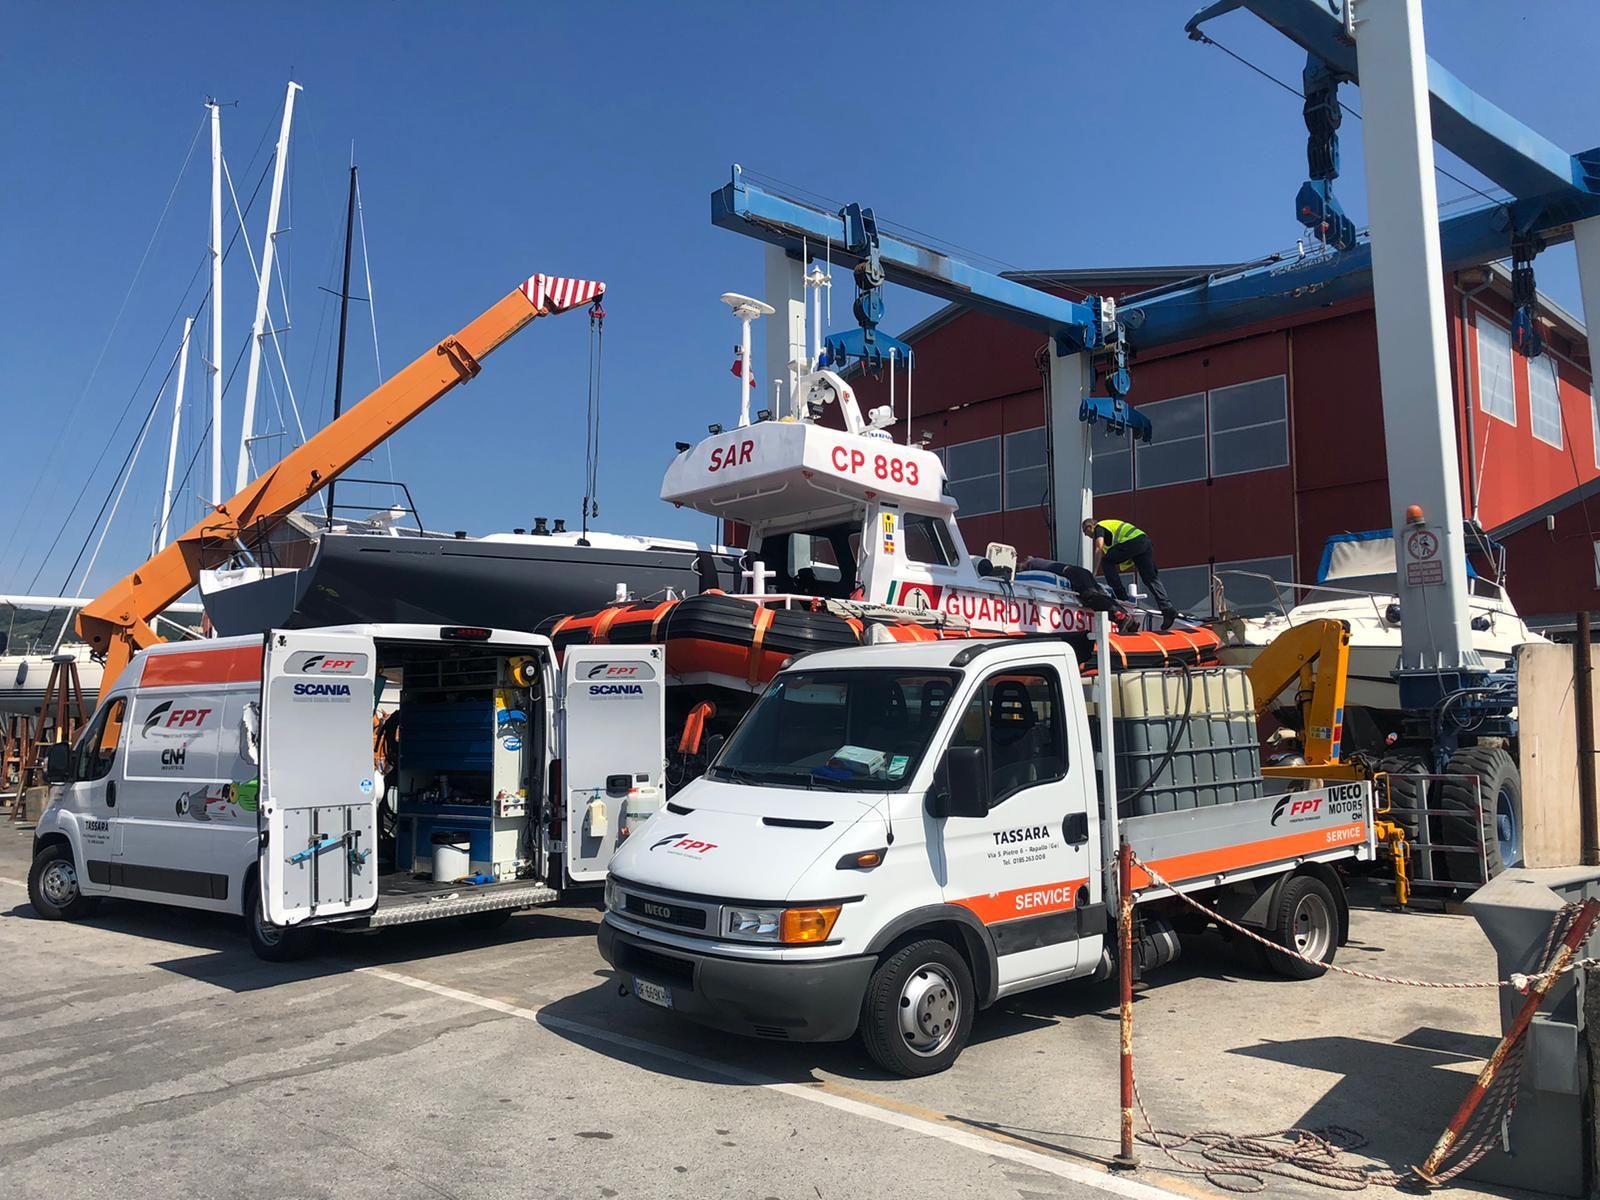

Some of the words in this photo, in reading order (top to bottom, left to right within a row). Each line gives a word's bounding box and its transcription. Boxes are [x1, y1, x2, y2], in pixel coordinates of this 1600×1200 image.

[708, 440, 754, 472] SAR
[831, 446, 865, 474] CP
[874, 454, 919, 486] 883
[946, 593, 1041, 626] GUARDIA
[321, 659, 356, 669] FPT
[606, 667, 638, 675] FPT
[294, 683, 351, 696] SCANIA
[589, 685, 643, 695] SCANIA
[165, 708, 213, 728] FPT
[161, 748, 186, 765] CNH
[1328, 784, 1362, 802] IVECO
[1290, 799, 1322, 816] FPT
[1328, 800, 1363, 815] MOTORS
[85, 820, 109, 831] TASSARA
[993, 825, 1050, 845] TASSARA
[1326, 827, 1361, 843] SERVICE
[673, 839, 718, 853] FPT
[1003, 848, 1019, 856] Pietro
[1015, 887, 1071, 910] SERVICE
[644, 903, 671, 919] IVECO
